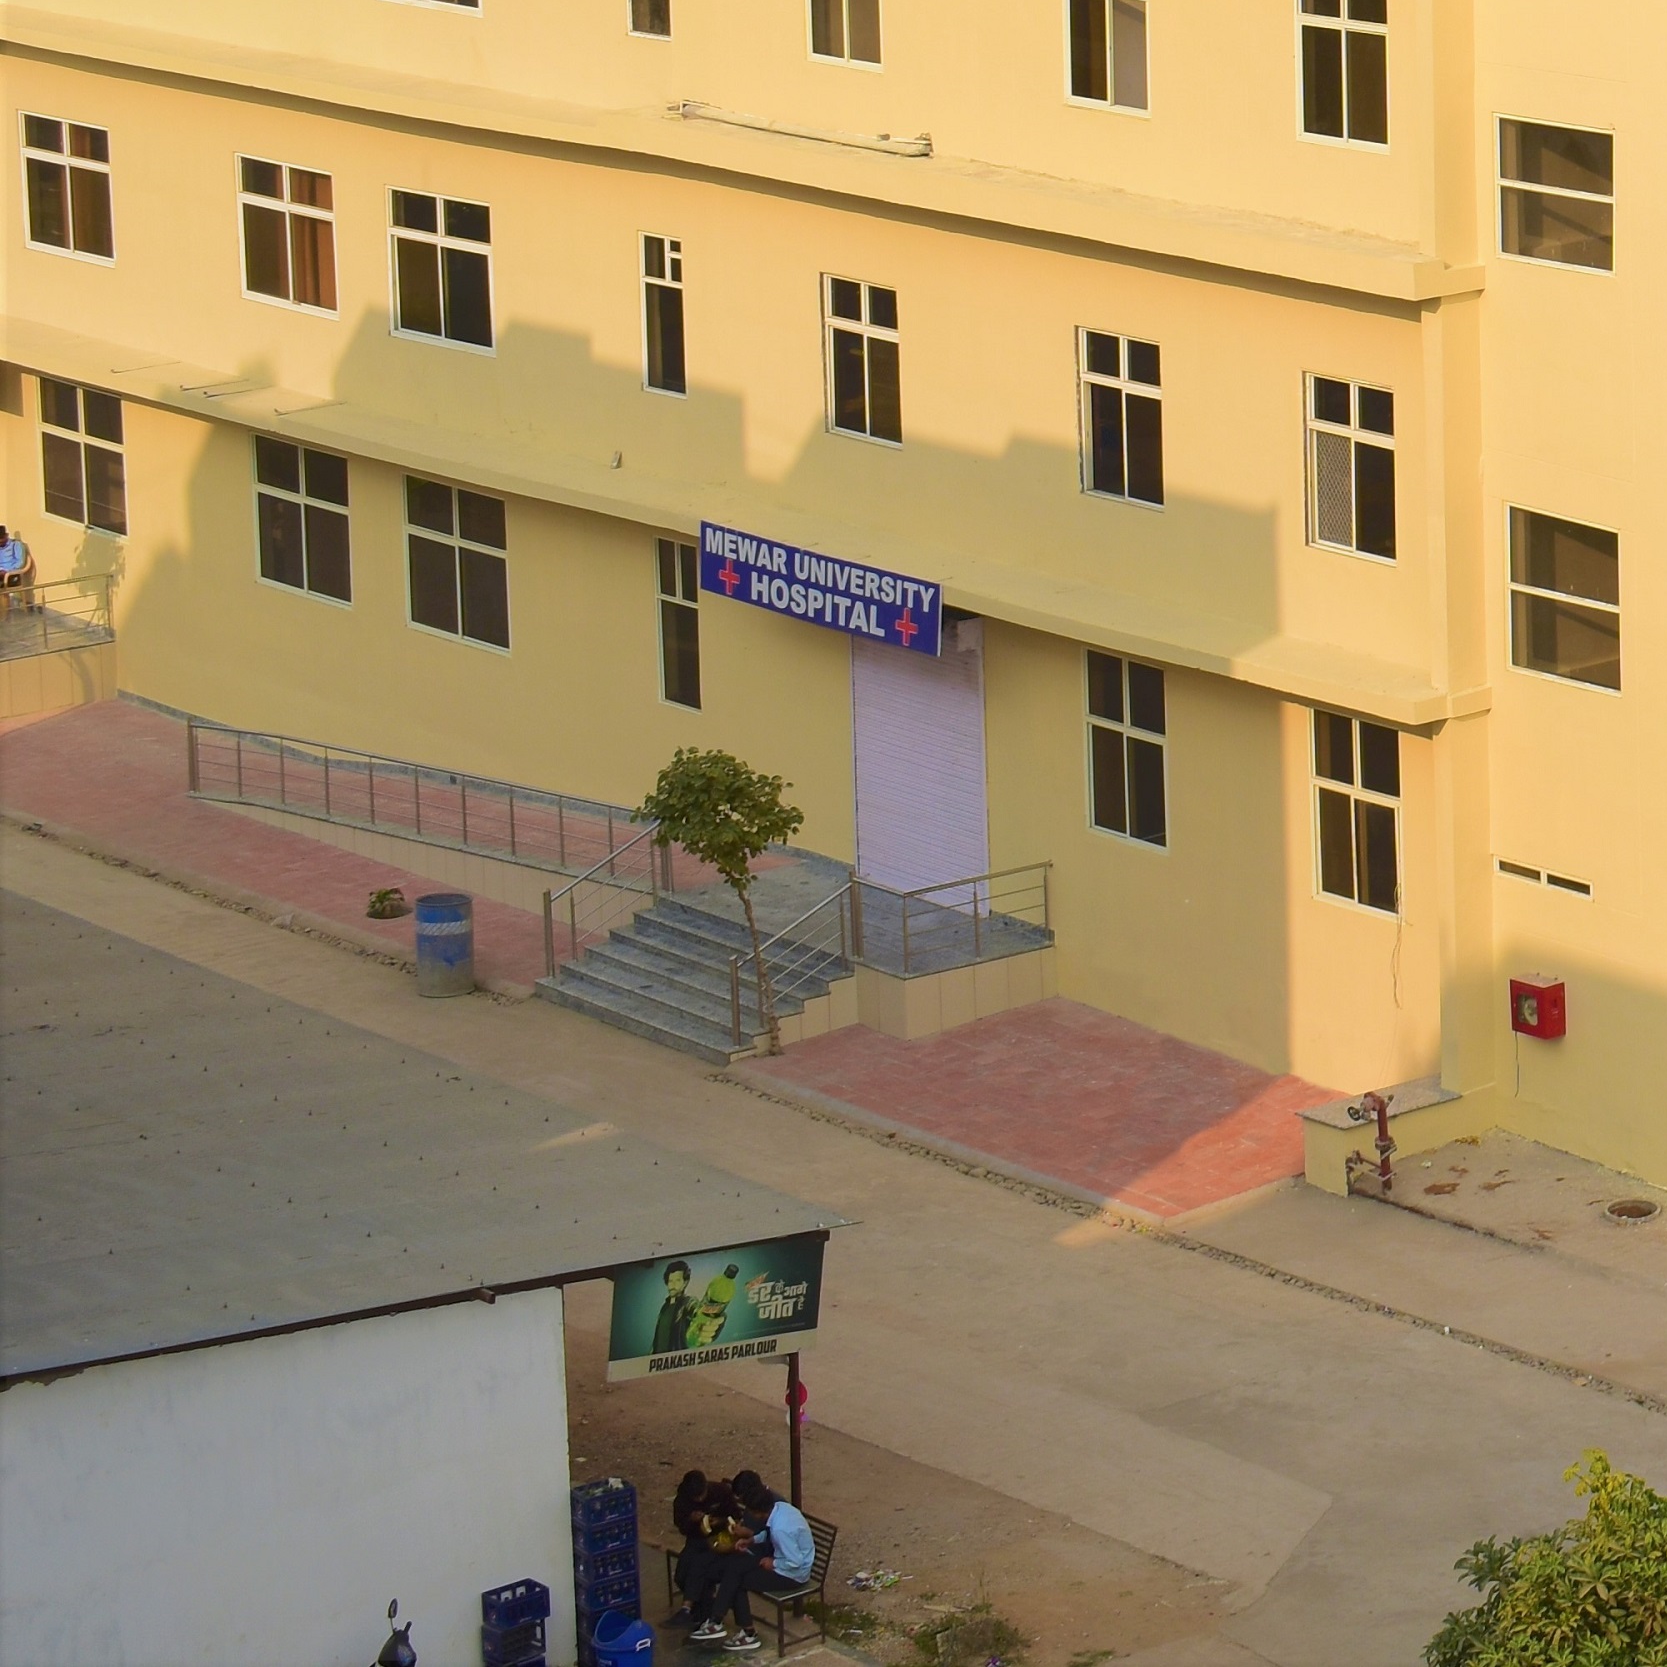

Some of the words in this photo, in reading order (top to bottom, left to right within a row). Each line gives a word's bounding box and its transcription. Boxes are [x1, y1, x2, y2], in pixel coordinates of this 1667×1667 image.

[705, 527, 787, 575] MEWAR
[794, 552, 935, 613] UNIVERSITY
[751, 571, 885, 637] HOSPITAL
[649, 1352, 696, 1373] PRAKASH
[697, 1346, 730, 1365] SARAS
[731, 1339, 777, 1360] PARLOUR
